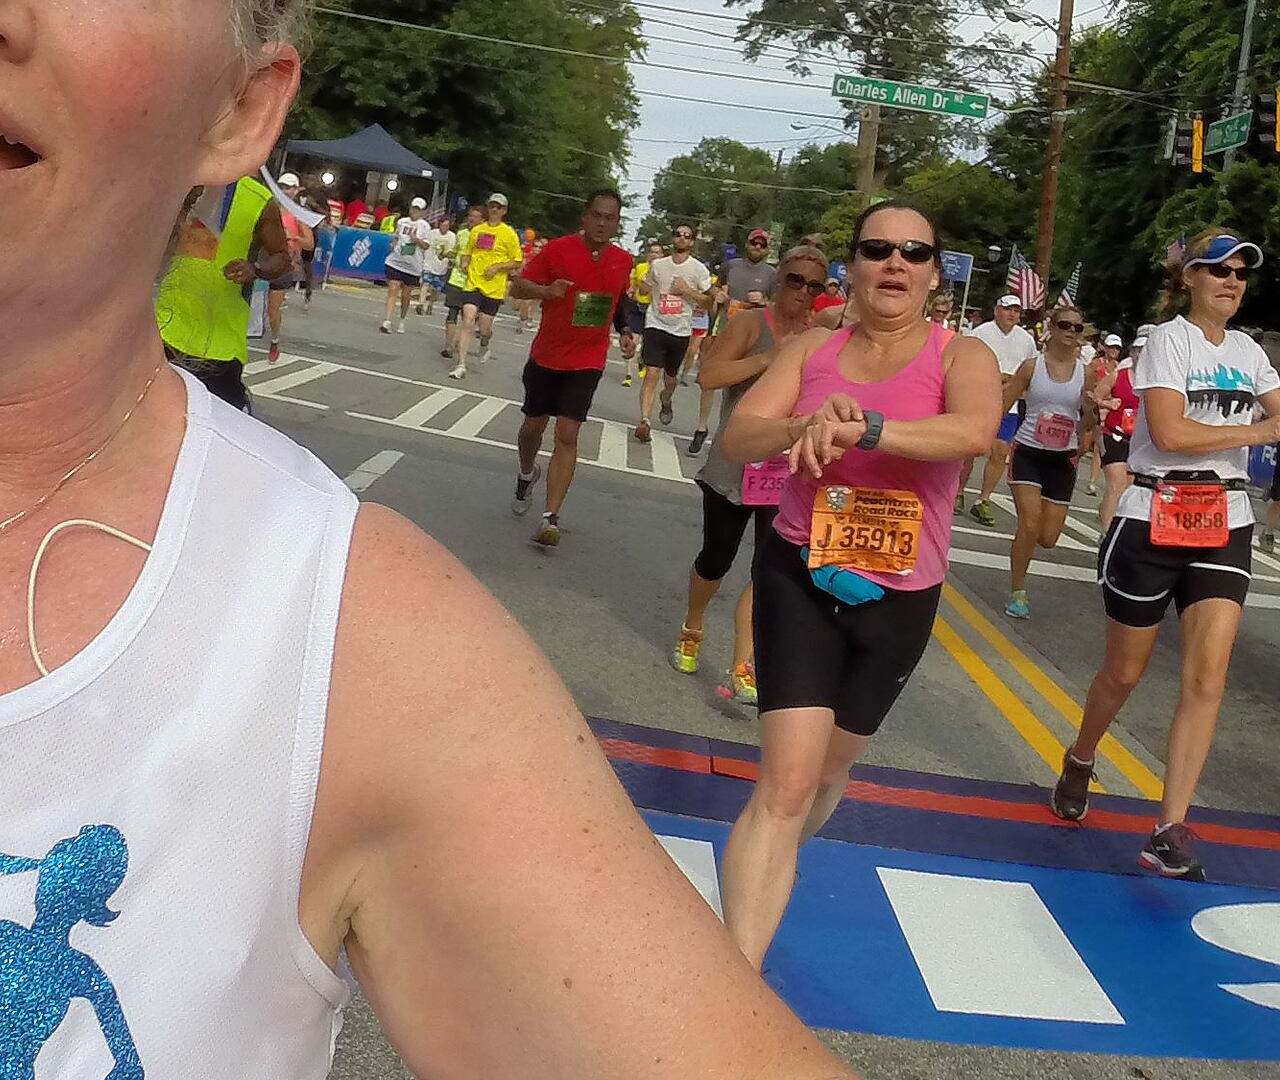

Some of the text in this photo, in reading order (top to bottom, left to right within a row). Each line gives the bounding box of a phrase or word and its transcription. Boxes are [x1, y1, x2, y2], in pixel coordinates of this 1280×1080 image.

[835, 78, 888, 100] Charles
[893, 87, 927, 107] Allen
[932, 93, 949, 109] Dr
[760, 476, 785, 490] 235
[854, 495, 919, 508] Peachtree
[853, 505, 918, 519] Road Race
[1173, 511, 1224, 529] 18858
[816, 524, 914, 556] J 35913
